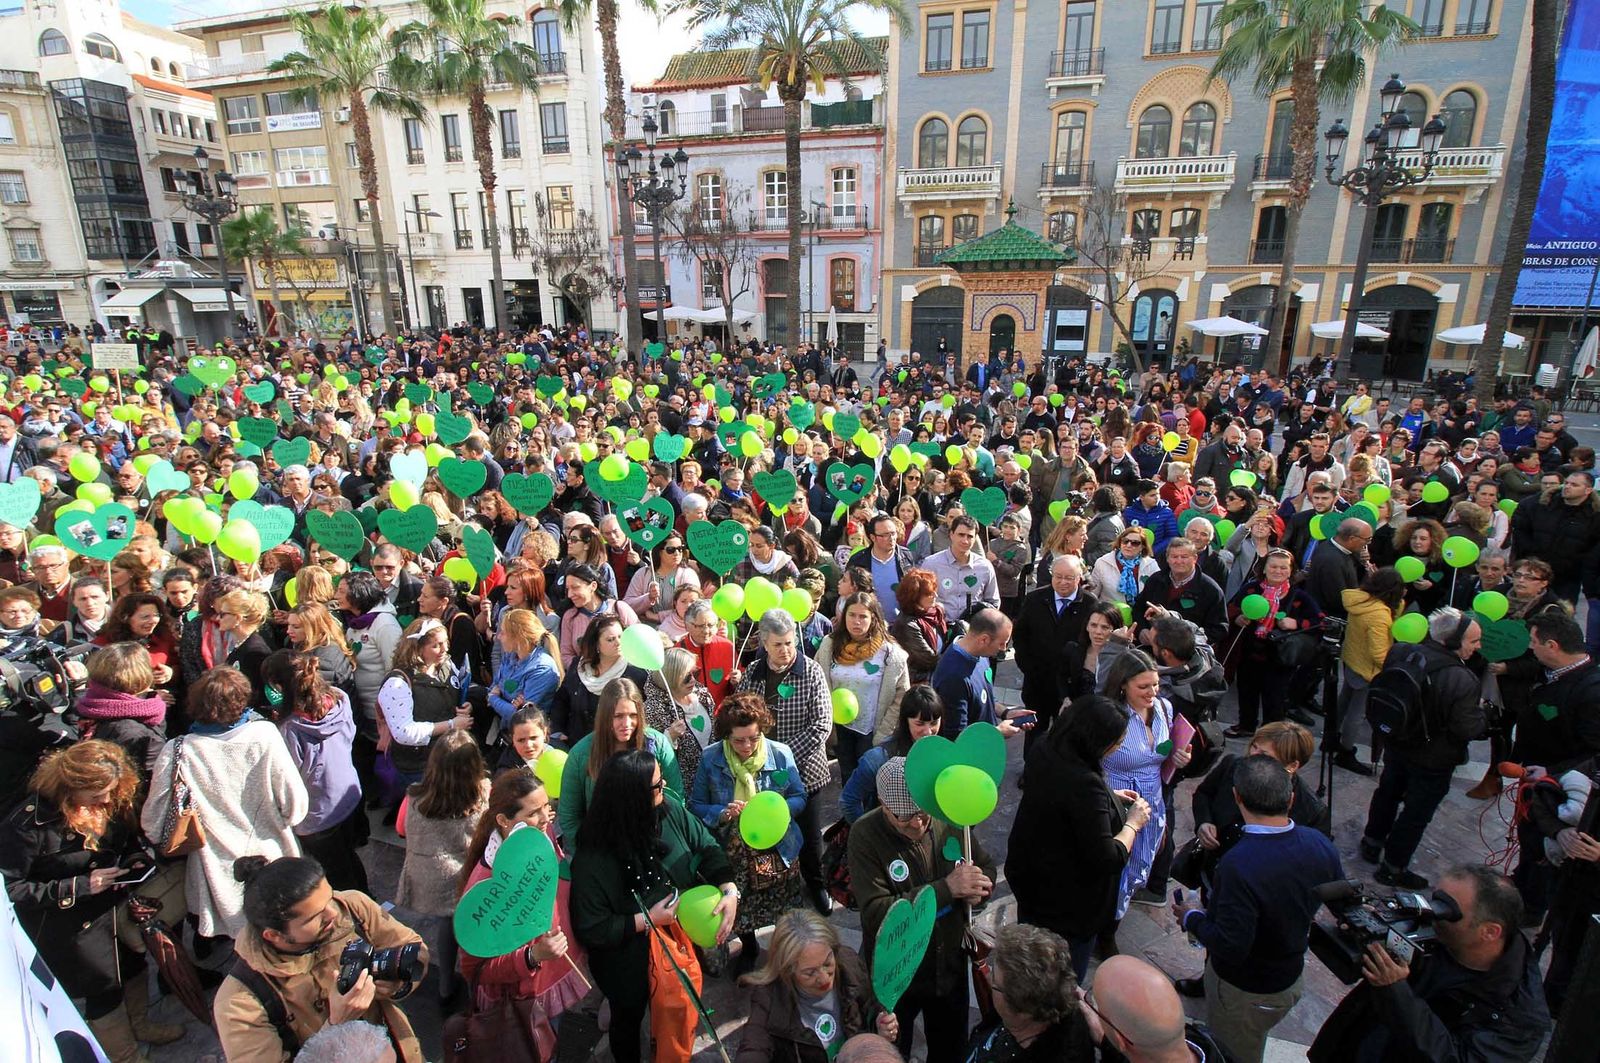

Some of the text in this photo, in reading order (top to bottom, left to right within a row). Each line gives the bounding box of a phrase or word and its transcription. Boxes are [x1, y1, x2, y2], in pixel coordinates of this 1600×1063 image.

[1544, 241, 1597, 250] ANTIGUO
[1554, 257, 1569, 266] DE
[471, 870, 513, 926] MARIA
[489, 855, 545, 931] ALMONTEÑA
[512, 872, 552, 927] VALIENTE
